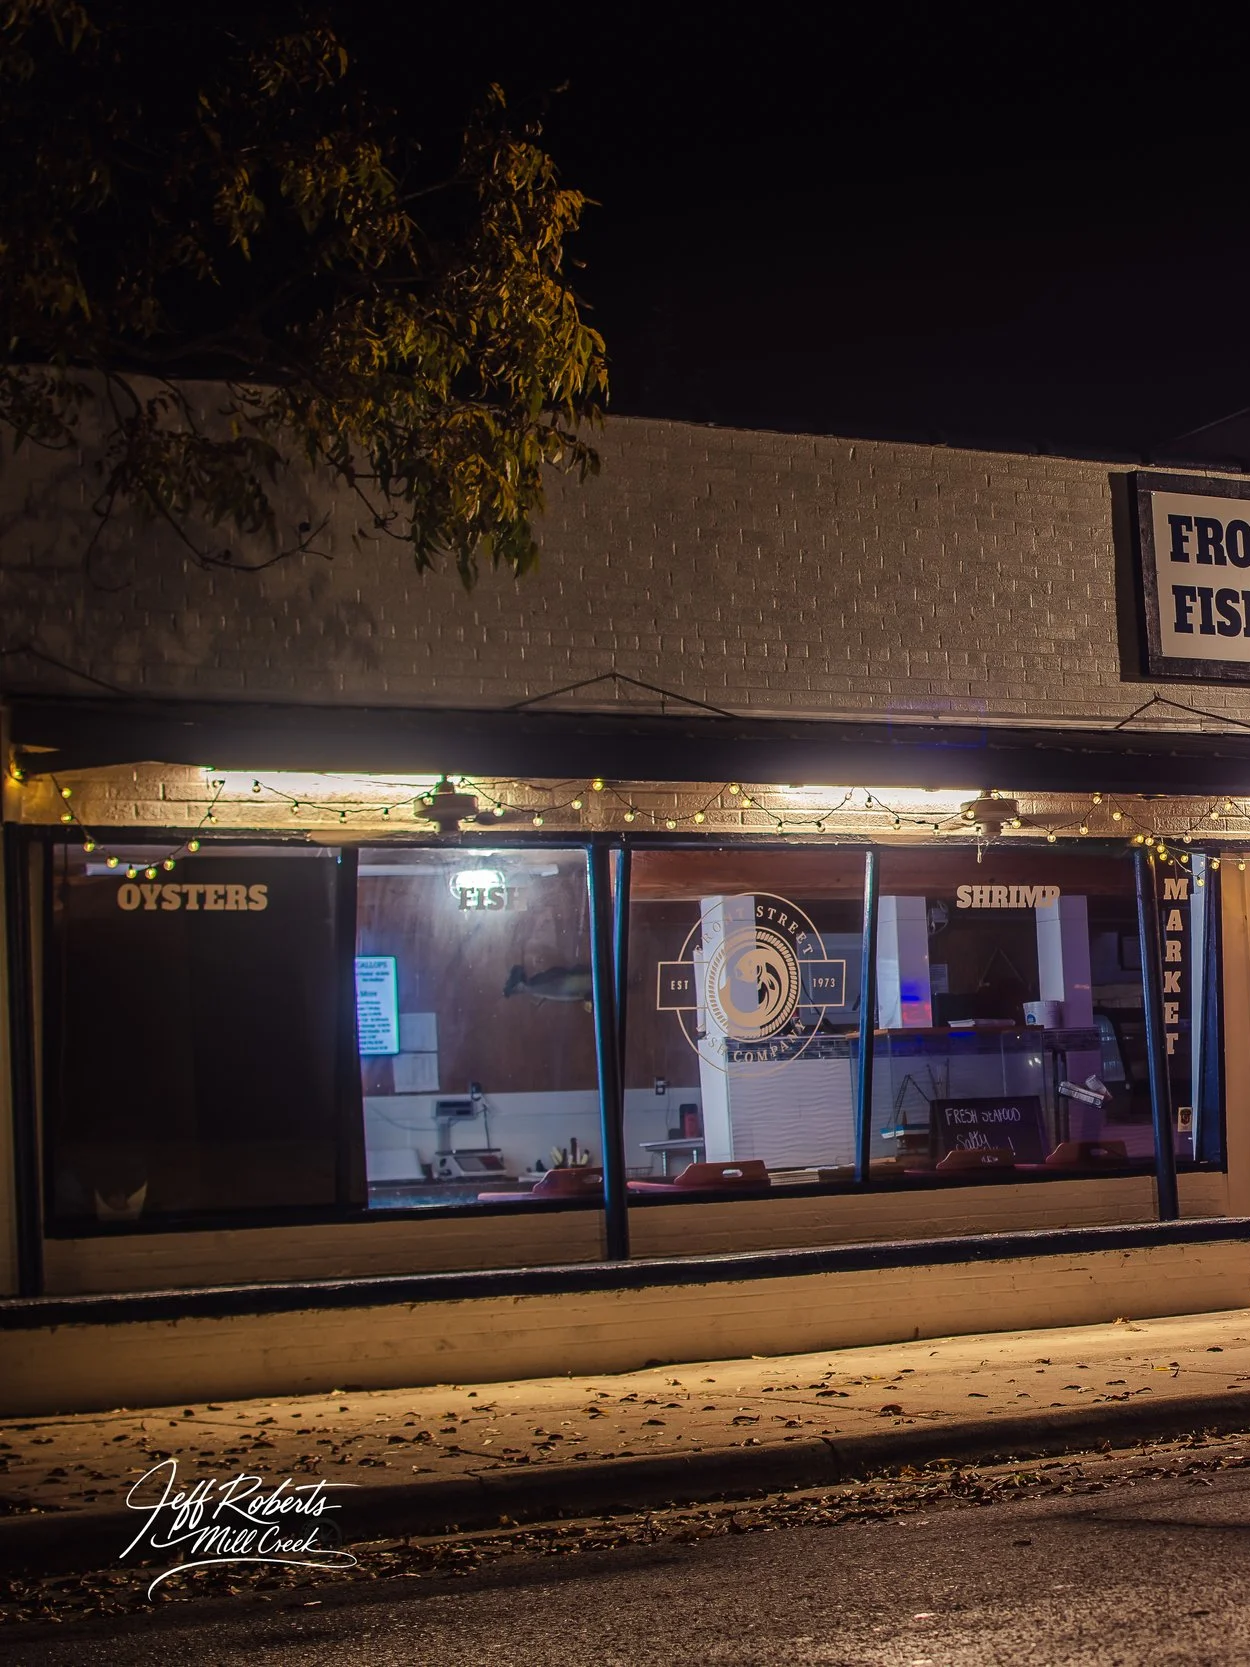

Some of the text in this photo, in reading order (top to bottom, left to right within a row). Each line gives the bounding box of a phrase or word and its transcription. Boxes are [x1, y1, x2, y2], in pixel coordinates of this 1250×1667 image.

[117, 884, 268, 911] OYSTERS
[459, 887, 528, 911] FISH
[956, 885, 1060, 908] SHRIMP
[756, 905, 814, 956] STREET
[1163, 878, 1189, 1055] MARKET
[670, 980, 689, 990] EST
[813, 978, 836, 988] 1973
[733, 1018, 807, 1063] COMPANY
[945, 1107, 979, 1126] FRESH
